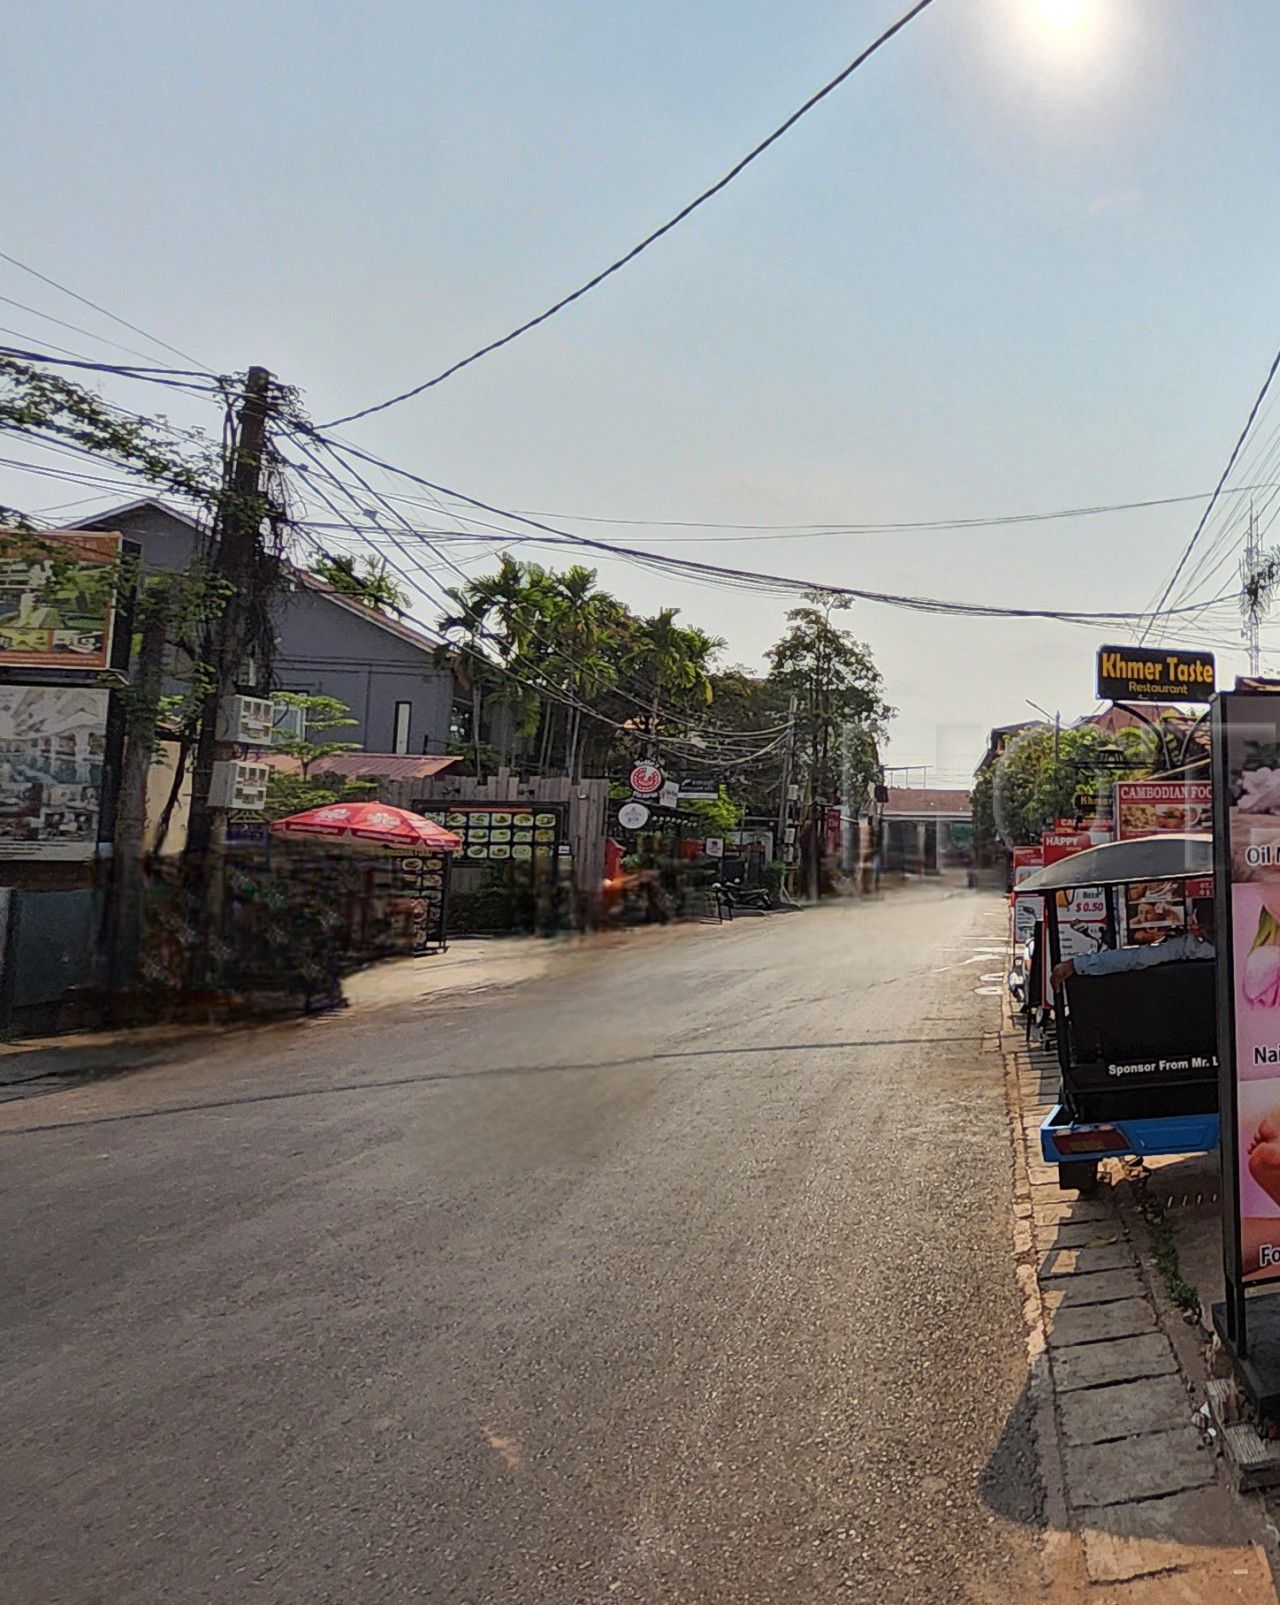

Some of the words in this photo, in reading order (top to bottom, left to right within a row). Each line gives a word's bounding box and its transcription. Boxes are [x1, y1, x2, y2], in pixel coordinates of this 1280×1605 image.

[1102, 653, 1163, 680] Khmer
[1166, 656, 1213, 683] Taste
[1128, 681, 1188, 694] Restaurant
[1121, 786, 1189, 799] CAMBODIAN
[1046, 836, 1079, 846] HAPPY
[1246, 846, 1271, 865] Oil
[1108, 1063, 1156, 1077] Sponsor
[1159, 1060, 1189, 1071] From
[1191, 1057, 1210, 1068] Mr.
